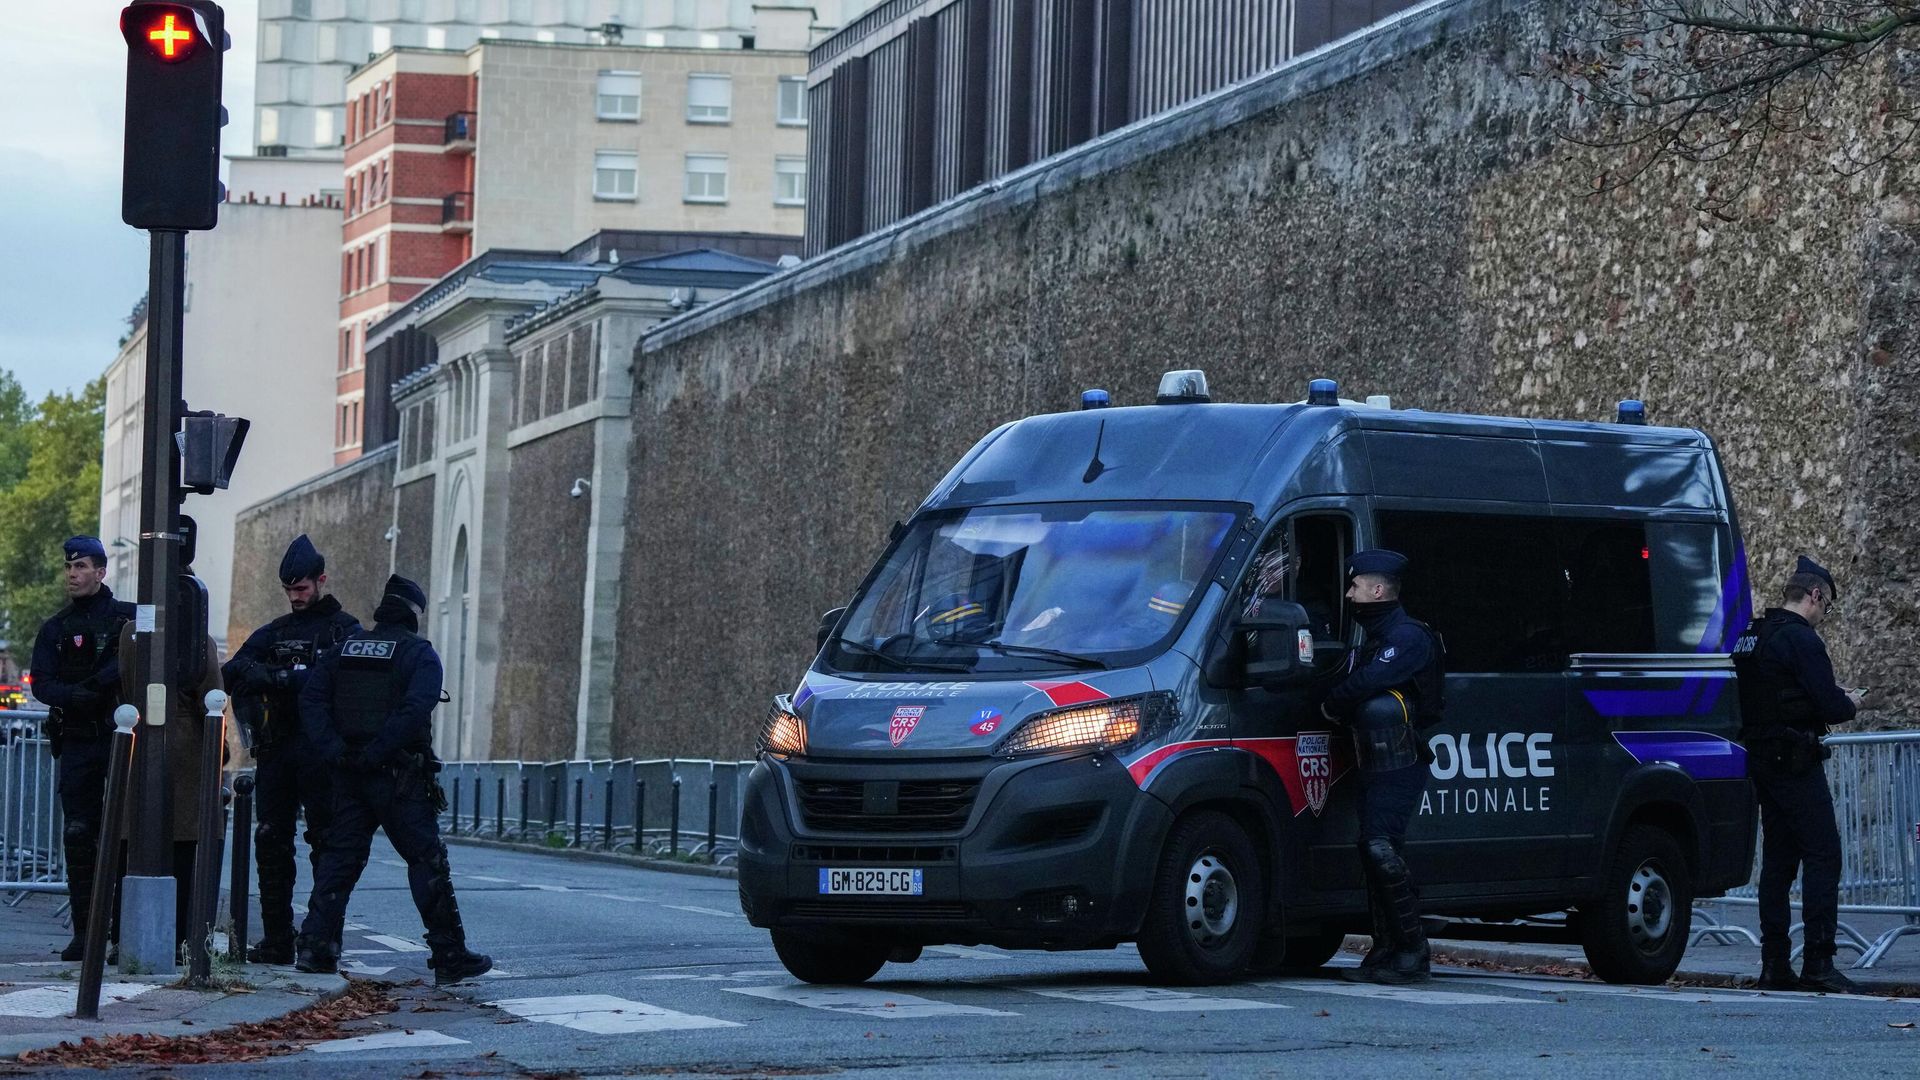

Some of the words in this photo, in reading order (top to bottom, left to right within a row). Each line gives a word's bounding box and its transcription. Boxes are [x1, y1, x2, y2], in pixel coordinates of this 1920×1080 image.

[348, 642, 389, 656] CRS
[1742, 635, 1758, 652] CRS
[854, 681, 977, 692] POLICE
[845, 690, 962, 699] NATIONALE
[981, 710, 993, 719] VI
[891, 718, 917, 727] CRS
[979, 722, 995, 732] 45
[1301, 736, 1328, 745] POLICE
[1298, 744, 1328, 754] NATIONALE
[1428, 732, 1555, 780] OLICE
[1301, 757, 1330, 777] CRS
[1419, 787, 1550, 815] ATIONALE
[832, 871, 910, 892] GM-829-CG
[913, 882, 922, 892] 69
